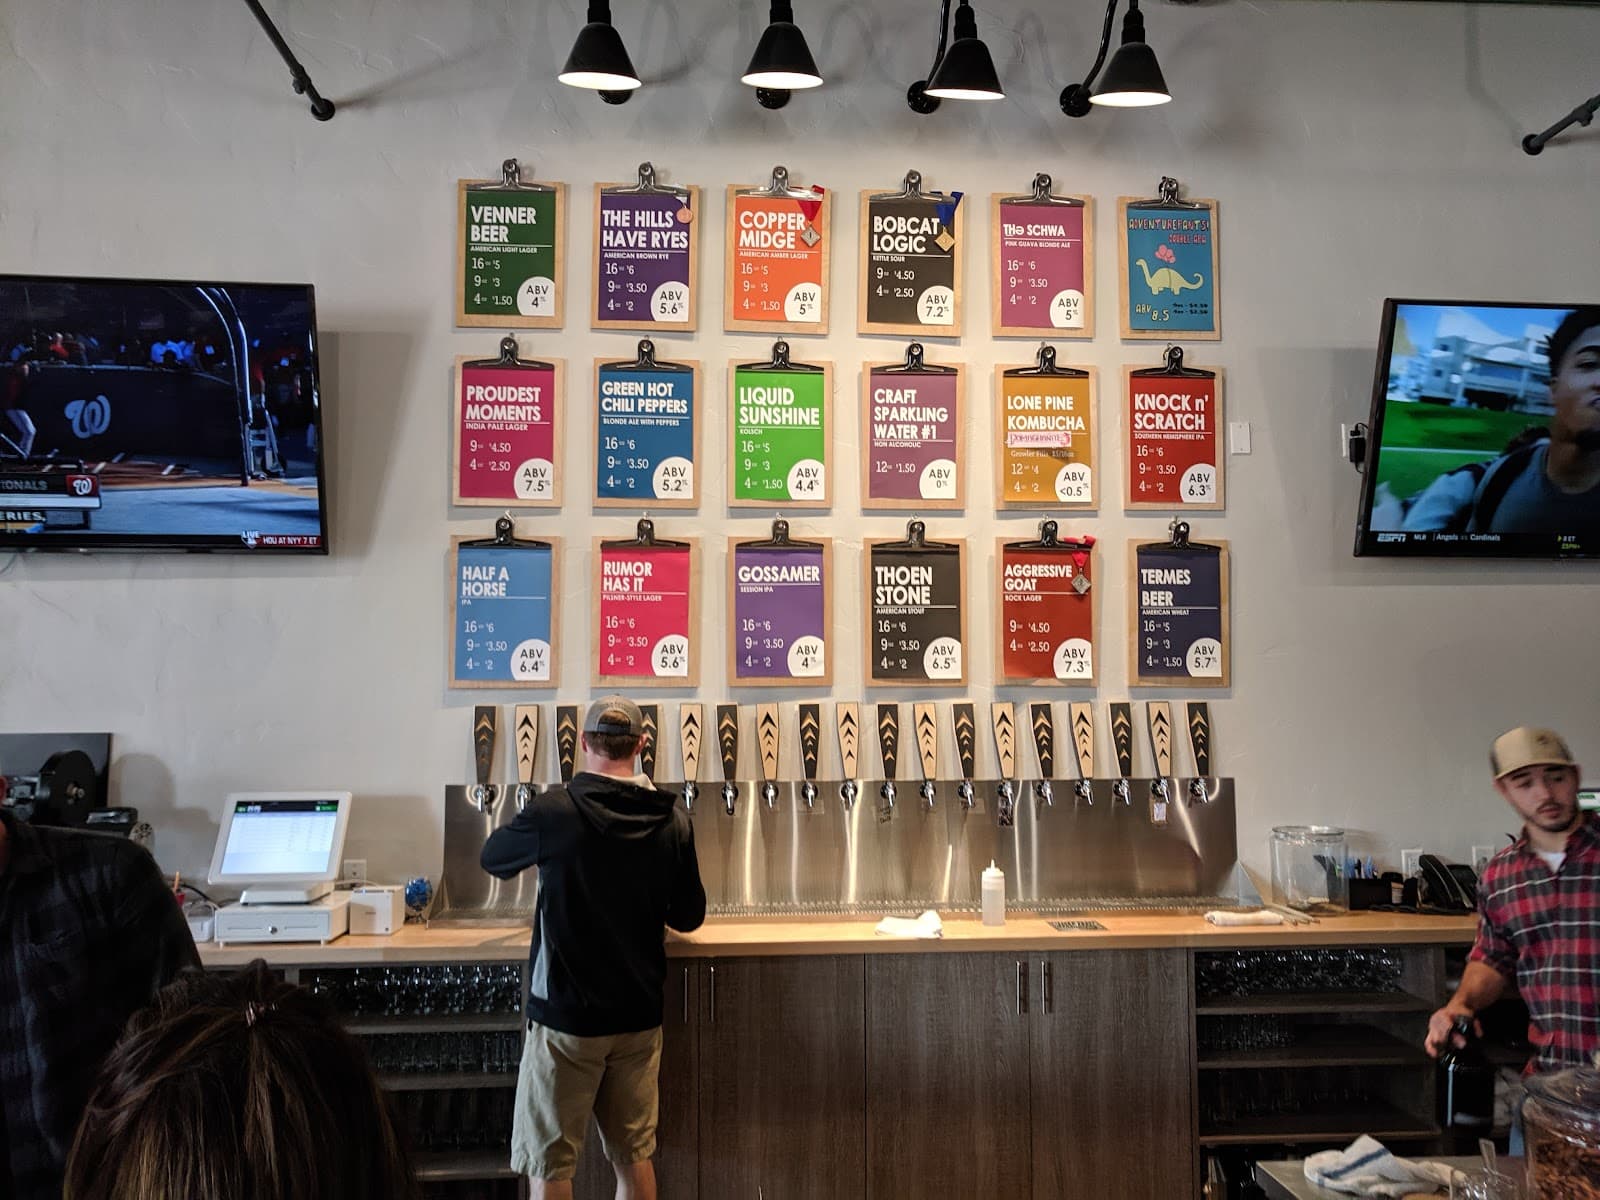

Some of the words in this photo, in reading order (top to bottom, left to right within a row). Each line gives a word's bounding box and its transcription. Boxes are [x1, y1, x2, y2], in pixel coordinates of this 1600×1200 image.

[471, 206, 536, 224] VENNER
[603, 210, 630, 227] THE
[635, 211, 673, 227] HILLS
[740, 211, 805, 230] COPPER
[873, 216, 939, 234] BOBCAT
[1027, 225, 1065, 236] SCHWA
[471, 225, 509, 242] BEER
[603, 230, 647, 247] HAVE
[652, 231, 688, 249] RYES
[740, 230, 795, 249] MIDGE
[873, 234, 926, 253] LOGIC
[527, 285, 549, 294] ABV
[660, 291, 682, 300] ABV
[794, 293, 816, 301] ABV
[926, 295, 948, 304] ABV
[1058, 299, 1078, 307] ABV
[467, 386, 541, 402] PROUDEST
[602, 381, 644, 396] GREEN
[648, 383, 673, 397] HOT
[740, 387, 794, 406] LIQUID
[874, 389, 917, 404] CRAFT
[602, 398, 634, 412] CHILI
[638, 399, 687, 413] PEPPERS
[1008, 396, 1041, 409] LONE
[1046, 396, 1073, 410] PINE
[1135, 394, 1191, 411] KNOCK
[1195, 395, 1208, 411] n'
[466, 404, 541, 421] MOMENTS
[740, 407, 819, 425] SUNSHINE
[874, 407, 948, 422] SPARKLING
[1008, 416, 1085, 430] KOMBUCHA
[1135, 413, 1205, 430] SCRATCH
[874, 424, 918, 439] WATER
[921, 425, 936, 439] #1
[524, 468, 546, 478] ABV
[663, 467, 686, 477] ABV
[796, 468, 818, 477] ABV
[929, 470, 950, 478] ABV
[1064, 472, 1085, 481] ABV
[1189, 474, 1210, 482] ABV
[1377, 533, 1406, 542] ESPN
[463, 566, 495, 581] HALF
[499, 567, 509, 581] A
[604, 562, 652, 576] RUMOR
[738, 566, 820, 582] GOSSAMER
[875, 566, 932, 585] THOEN
[1005, 565, 1072, 577] AGGRESSIVE
[603, 577, 630, 591] HAS
[634, 578, 644, 592] IT
[1005, 579, 1037, 590] GOAT
[1141, 569, 1191, 585] TERMES
[462, 582, 507, 596] HORSE
[876, 586, 930, 605] STONE
[1142, 591, 1173, 607] BEER
[521, 649, 543, 658] ABV
[661, 645, 683, 654] ABV
[797, 645, 817, 654] ABV
[932, 646, 954, 655] ABV
[1063, 649, 1086, 658] ABV
[1194, 646, 1215, 655] ABV
